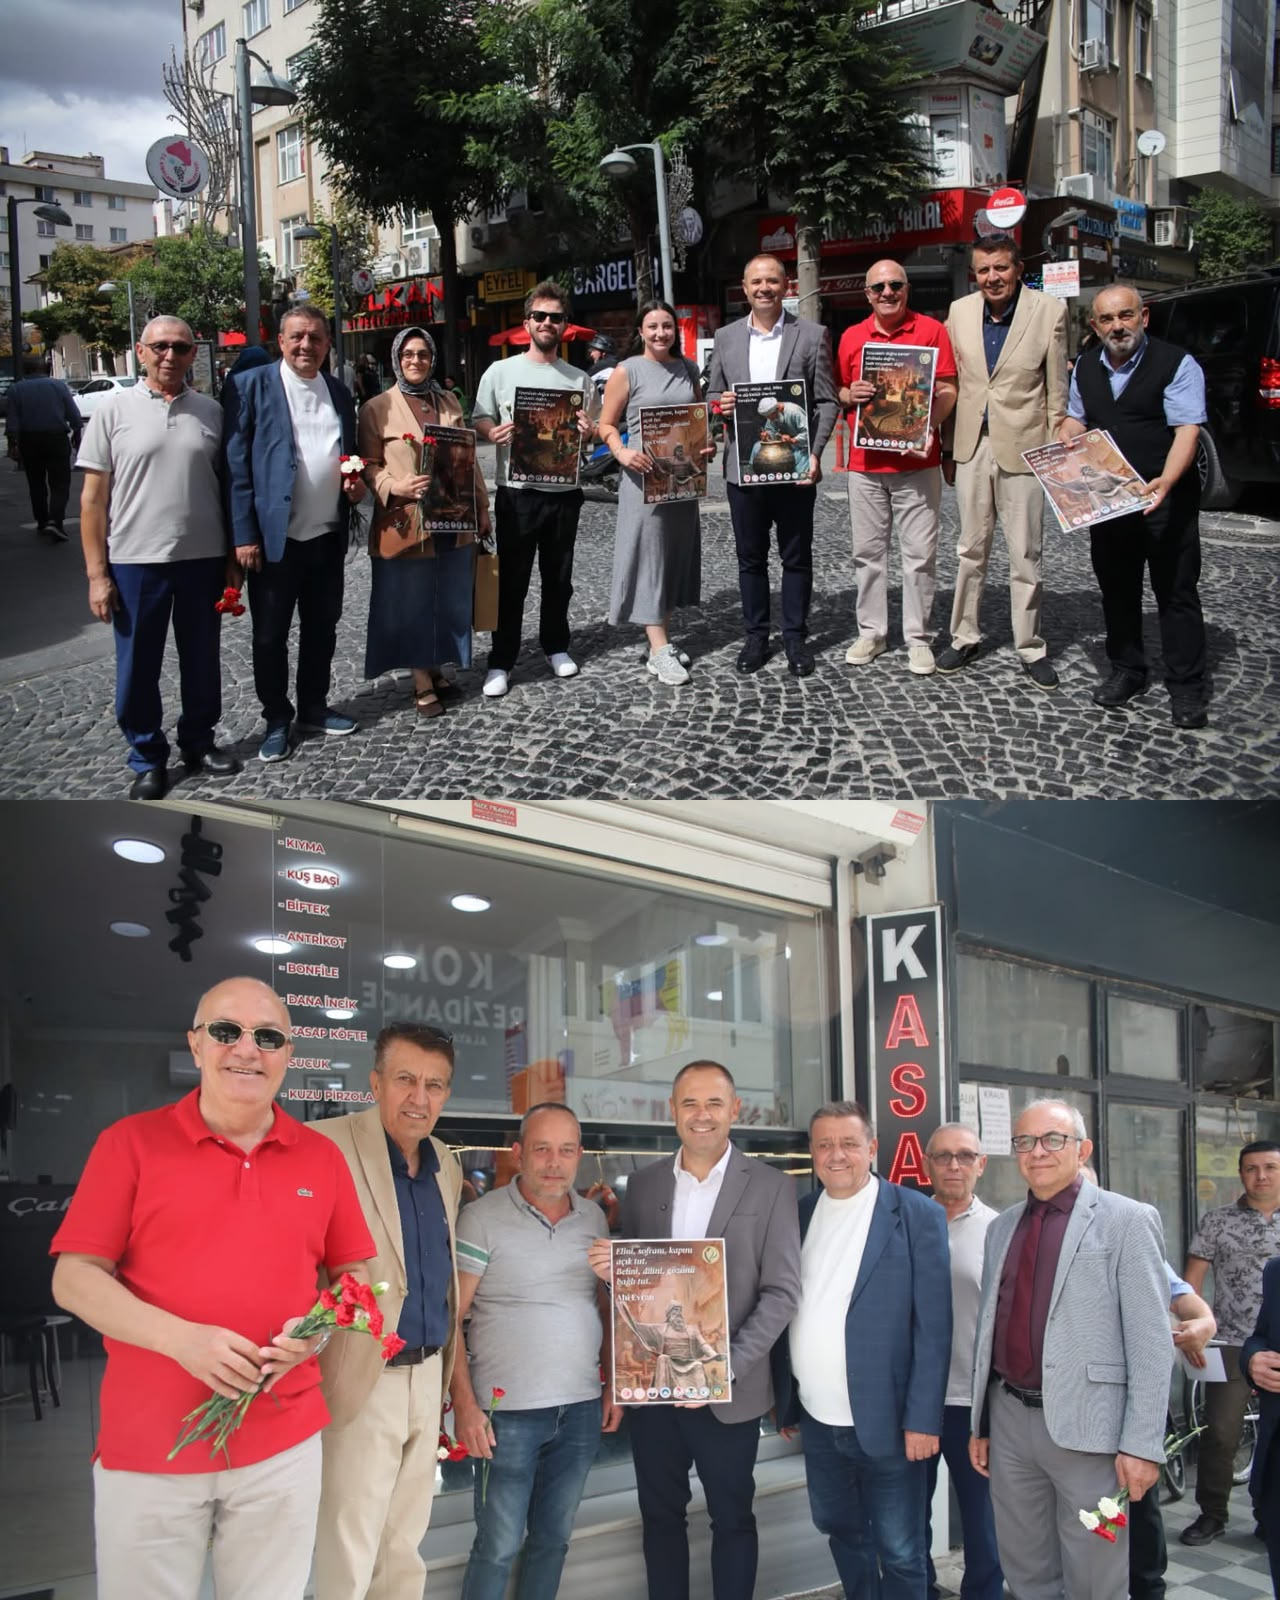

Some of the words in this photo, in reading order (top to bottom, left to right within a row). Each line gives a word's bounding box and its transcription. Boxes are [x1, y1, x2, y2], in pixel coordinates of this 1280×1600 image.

[486, 271, 522, 292] EYFEL
[573, 257, 659, 295] BARGEL
[360, 279, 444, 312] LKAN
[285, 837, 326, 855] KIYMA
[286, 869, 311, 884] KUŞ
[313, 873, 340, 888] BAŞI
[285, 898, 331, 917] BİFTEK
[286, 930, 347, 949] ANTRİKOT
[286, 961, 340, 979] BONFİLE
[286, 993, 324, 1007] DANA
[324, 994, 358, 1011] İNCİK
[329, 1026, 368, 1042] KÖFTE
[287, 1057, 331, 1070] SUCUK
[881, 924, 932, 1185] KASA
[288, 1088, 323, 1101] KUZU
[324, 1088, 375, 1103] PİRZOLA
[616, 1247, 636, 1255] Elini,
[637, 1246, 667, 1256] sofranı,
[668, 1246, 693, 1256] kapını
[616, 1257, 632, 1267] açık
[666, 1265, 696, 1276] gözünü
